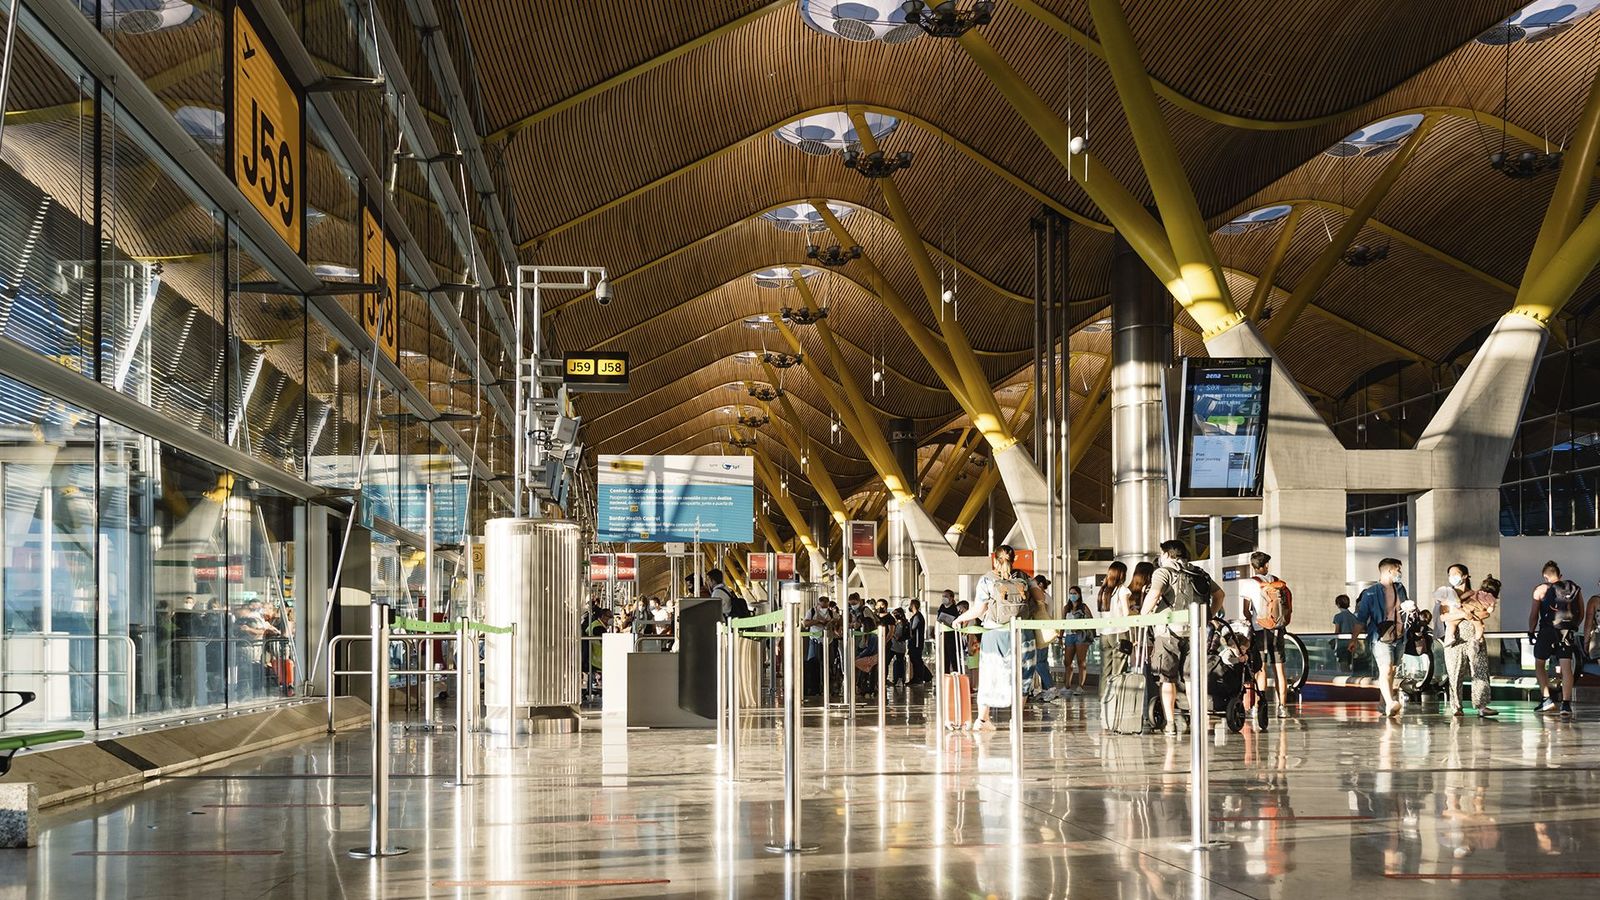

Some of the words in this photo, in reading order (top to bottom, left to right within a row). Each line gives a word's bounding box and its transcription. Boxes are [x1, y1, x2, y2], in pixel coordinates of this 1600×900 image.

[242, 97, 294, 228] J59
[570, 362, 590, 372] J59
[602, 362, 622, 372] J58
